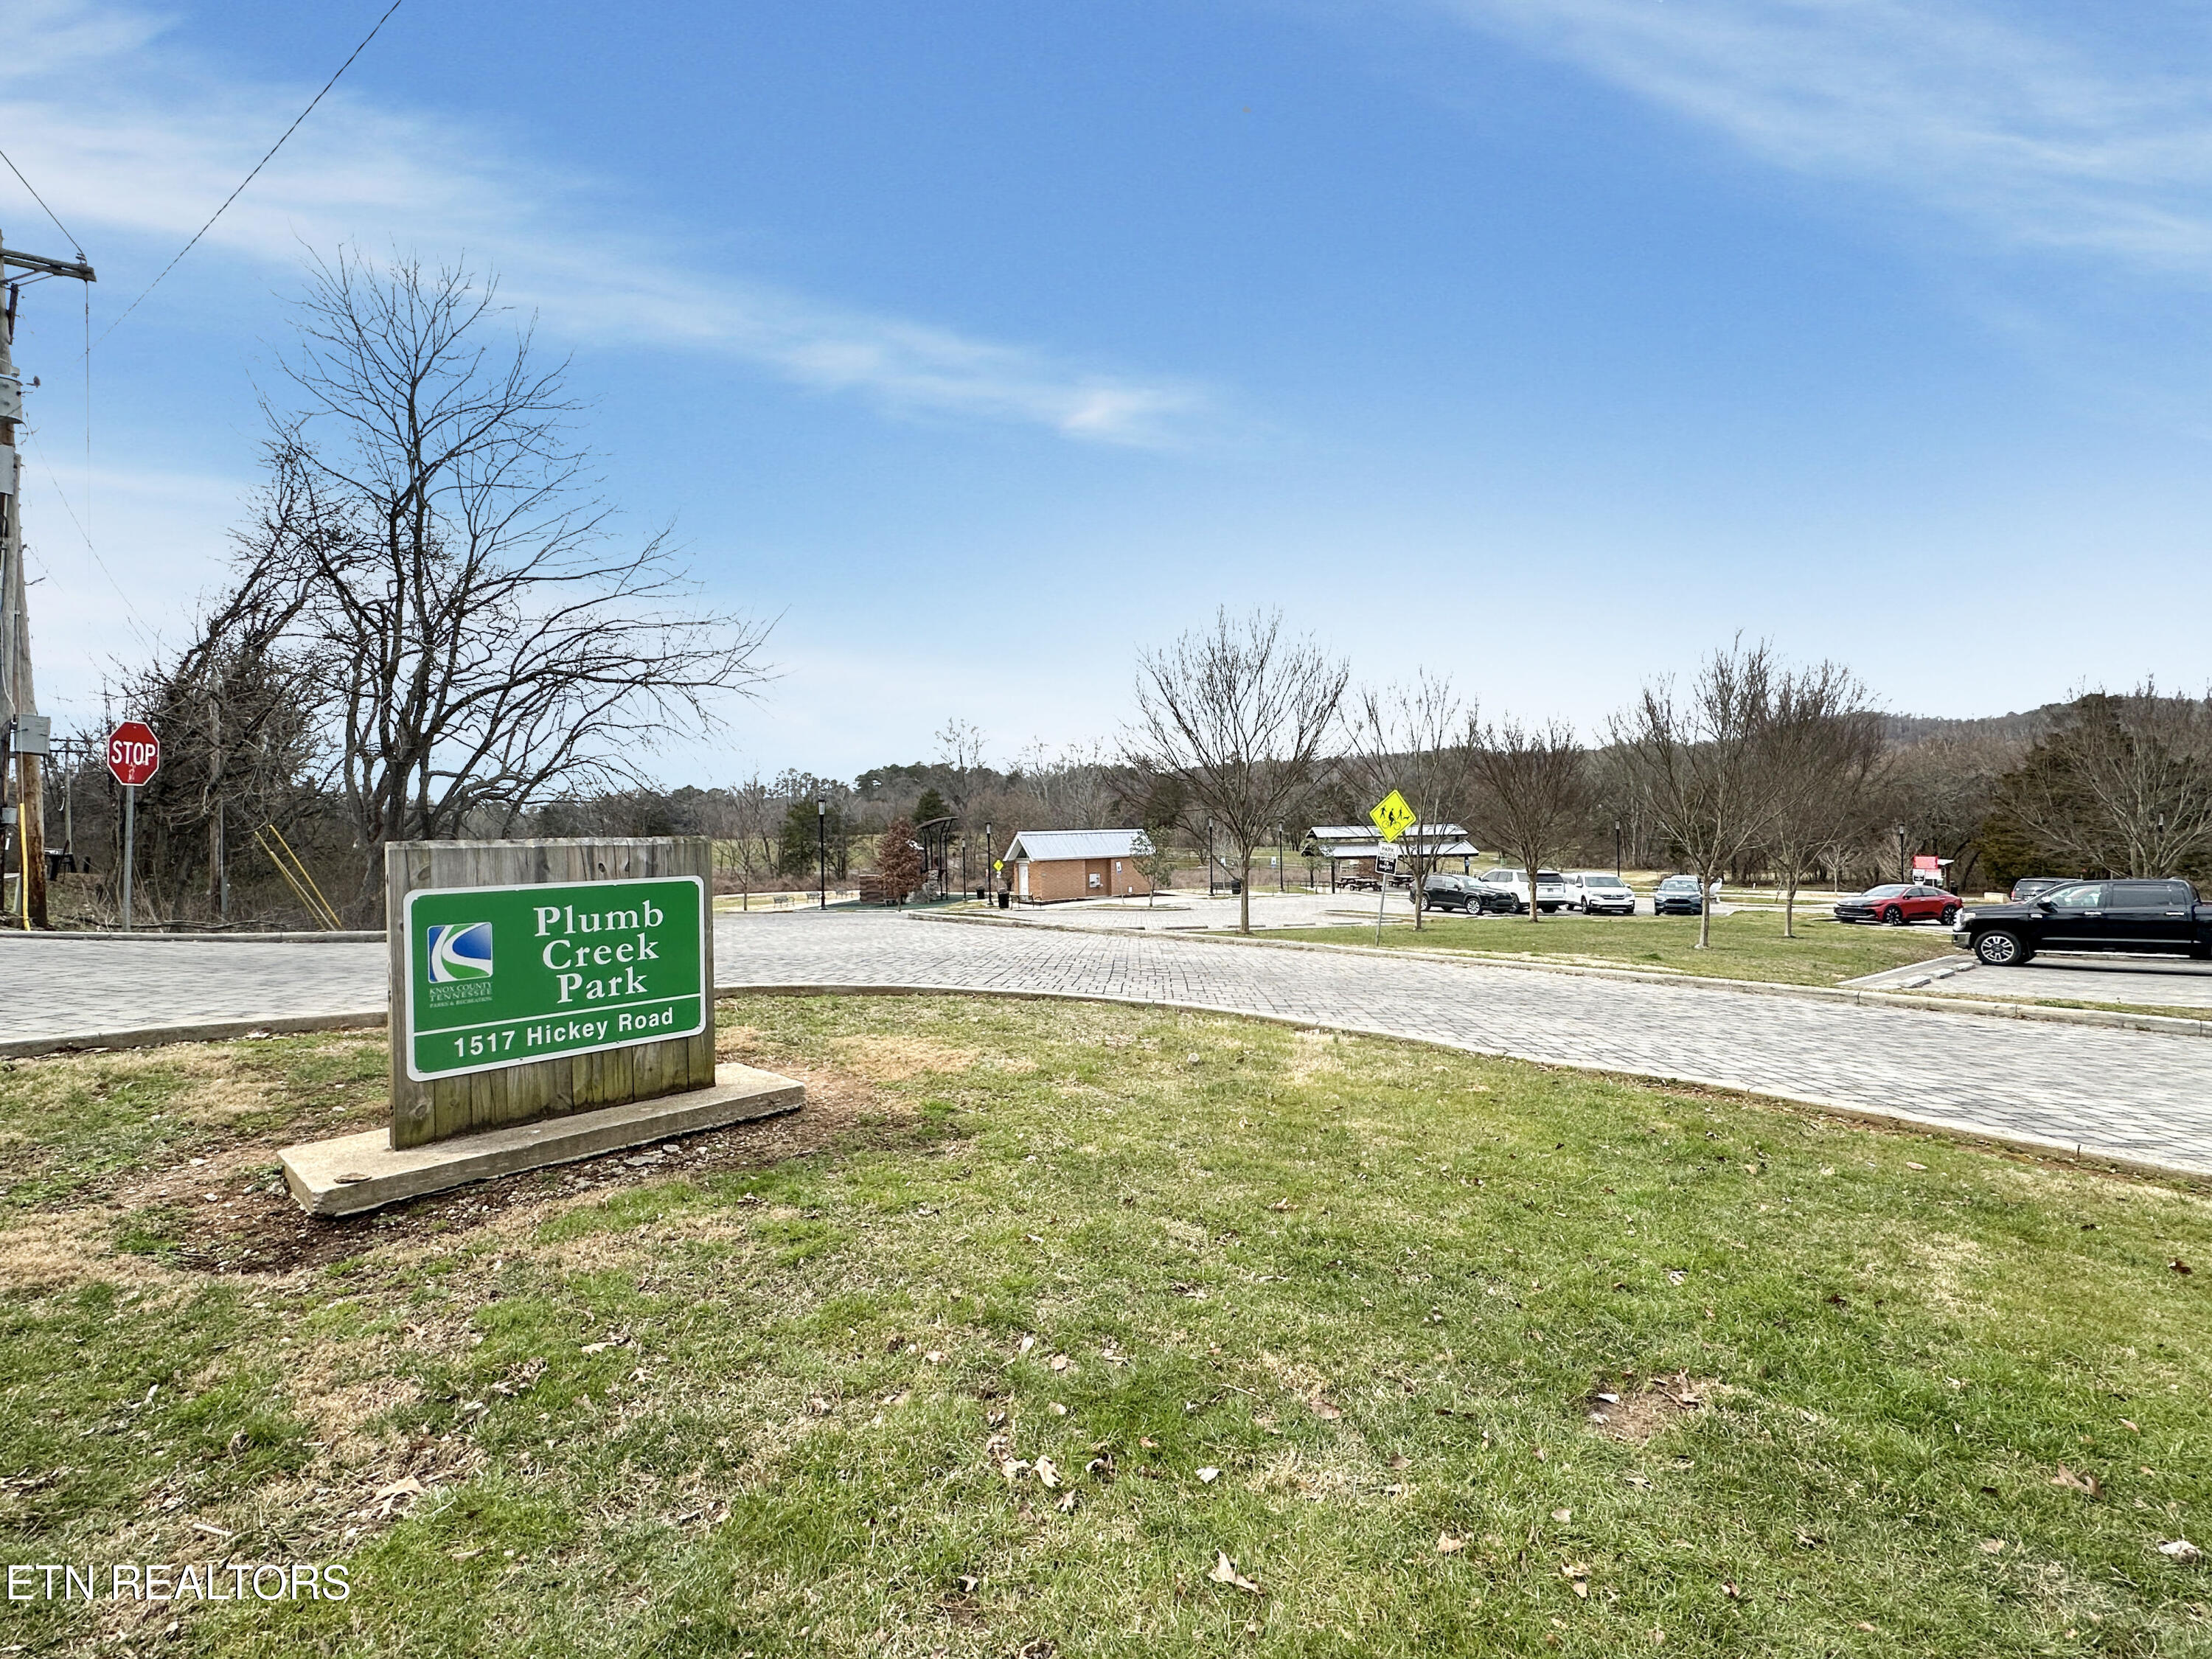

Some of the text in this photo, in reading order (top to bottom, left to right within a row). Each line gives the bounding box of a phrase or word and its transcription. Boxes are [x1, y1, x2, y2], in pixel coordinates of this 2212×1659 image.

[111, 740, 156, 765] STOP
[533, 900, 664, 937] Plumb
[543, 932, 660, 970] Creek
[429, 982, 492, 995] KNOX COUNTY
[429, 989, 493, 1002] TENNESSEE
[556, 966, 648, 1004] Park
[456, 997, 493, 1006] RECREATION
[454, 1006, 673, 1058] 1517 Hickey Road
